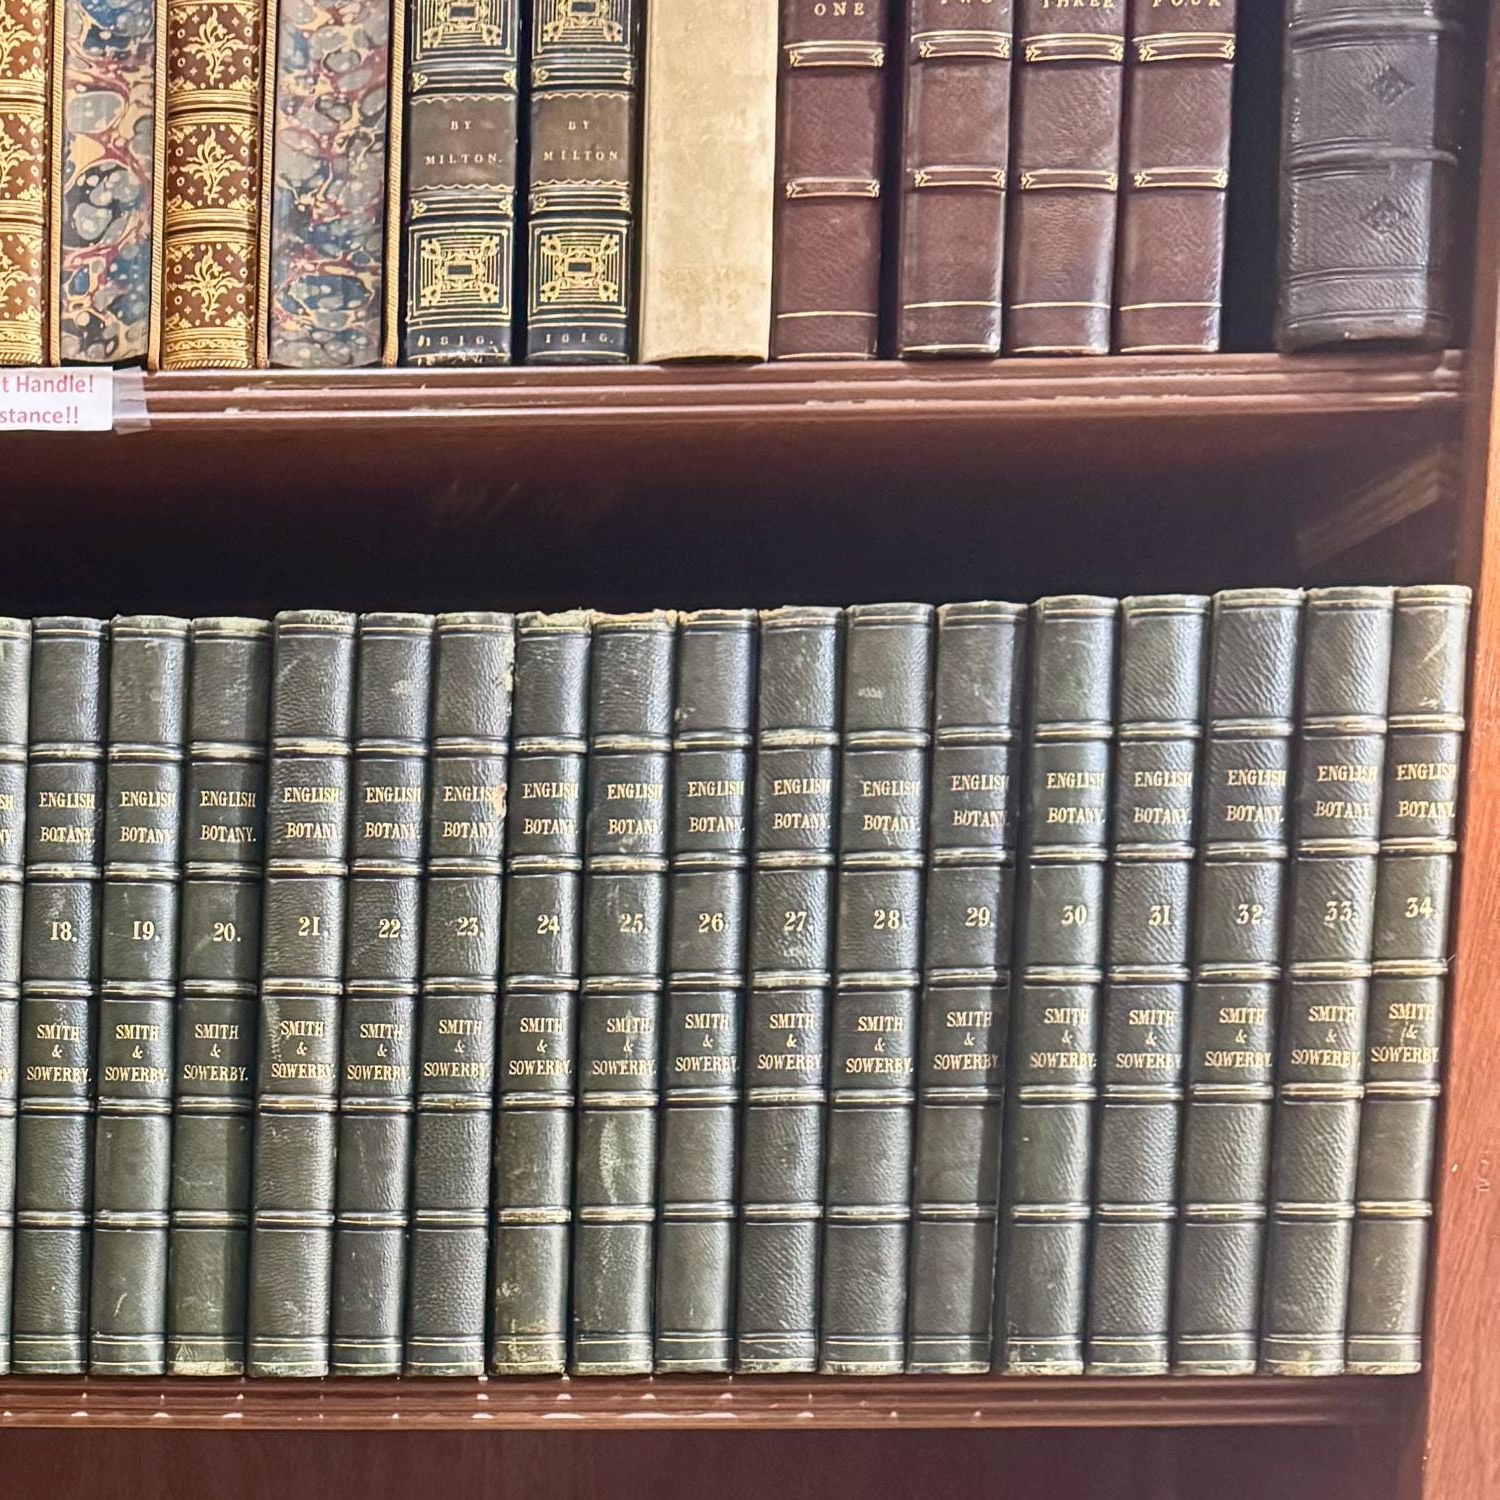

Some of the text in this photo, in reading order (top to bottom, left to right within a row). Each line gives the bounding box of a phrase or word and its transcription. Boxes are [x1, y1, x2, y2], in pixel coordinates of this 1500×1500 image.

[814, 2, 865, 16] ONE
[451, 120, 473, 131] BY
[568, 120, 590, 131] BY
[16, 374, 94, 394] Handle!
[1396, 763, 1457, 781] ENGLISH
[861, 780, 918, 797] ENGLISH
[199, 790, 256, 808] ENGLISH
[200, 825, 257, 843] BOTANY.
[213, 923, 242, 942] 20.
[1389, 1003, 1435, 1020] SMITH
[195, 1024, 239, 1040] SMITH
[858, 1016, 903, 1033] SMITH
[1405, 1023, 1418, 1039] &
[210, 1044, 221, 1058] &
[874, 1038, 886, 1052] &
[184, 1064, 249, 1081] SOWERBY.
